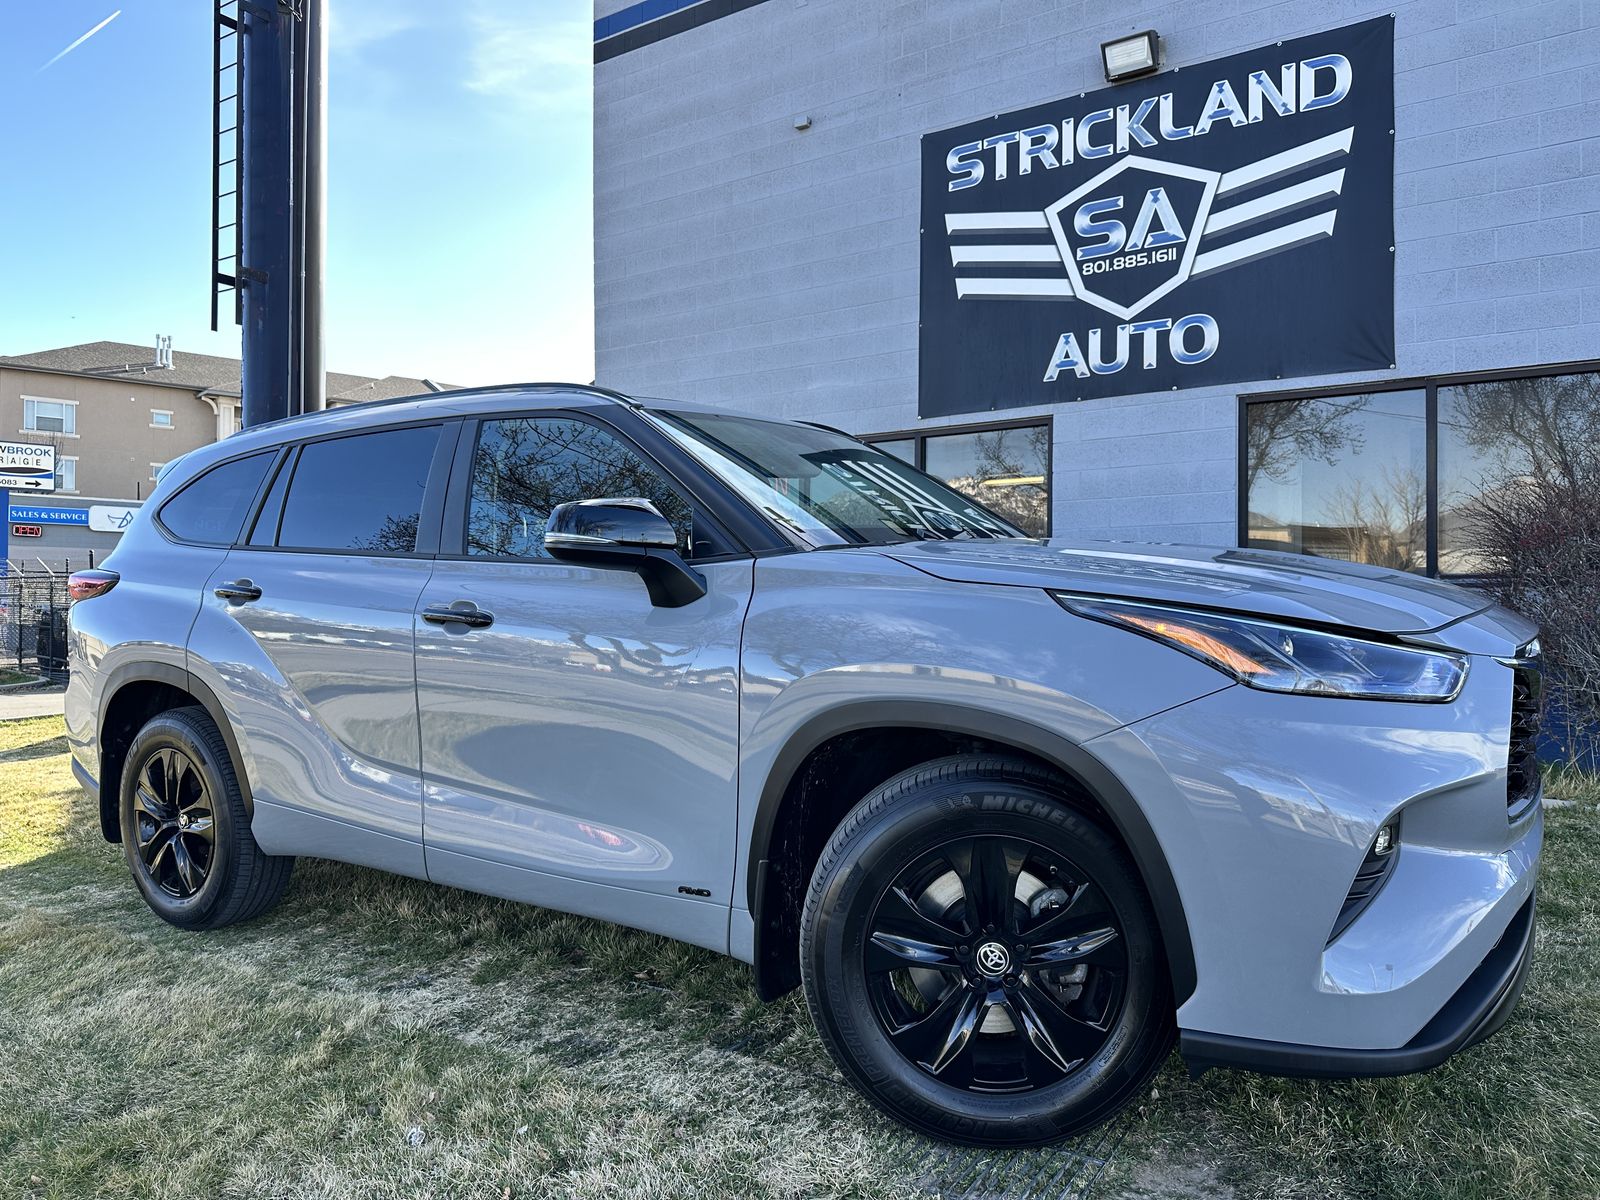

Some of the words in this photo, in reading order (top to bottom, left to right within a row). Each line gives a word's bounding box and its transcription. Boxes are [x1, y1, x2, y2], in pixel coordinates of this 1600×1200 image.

[946, 54, 1353, 191] STRICKLAND
[1073, 187, 1186, 261] SA
[1082, 247, 1177, 275] 801.885.1611
[1043, 313, 1219, 382] AUTO
[11, 510, 39, 519] SALES
[40, 511, 48, 519] &
[50, 512, 87, 521] SERVICE
[14, 526, 41, 536] OPEN
[678, 885, 712, 898] AWD
